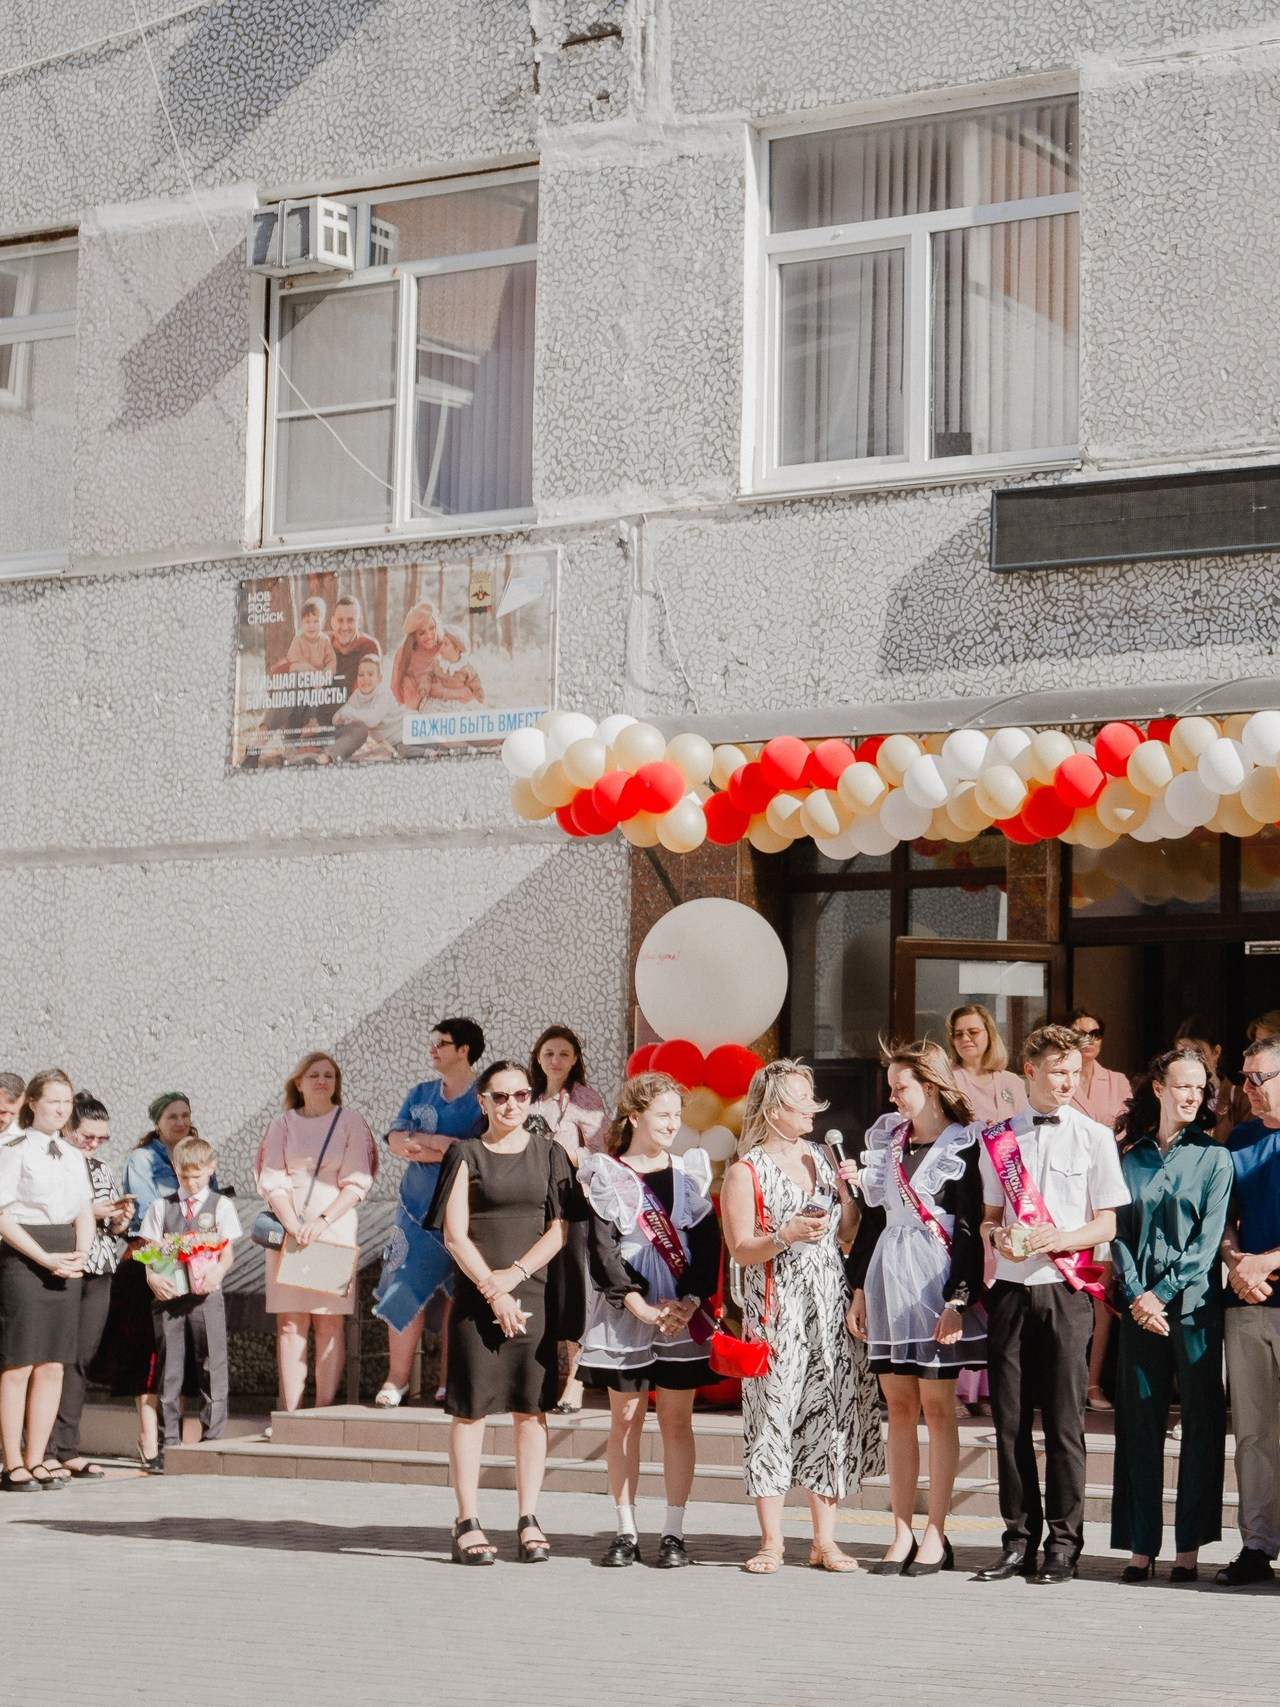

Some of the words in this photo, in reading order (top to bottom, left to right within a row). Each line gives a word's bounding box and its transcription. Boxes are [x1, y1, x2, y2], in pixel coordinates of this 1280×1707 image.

[248, 591, 271, 603] НОВ
[247, 602, 270, 614] РОС
[247, 611, 284, 625] СИЙСК
[297, 670, 332, 688] СЕМЬЯ
[245, 691, 295, 710] БОЛЬШАЯ
[297, 686, 347, 707] РАДОСТЬ!
[411, 717, 456, 737] ВАЖНО
[459, 714, 495, 735] БЫТЬ
[498, 710, 548, 732] ВМЕСТ
